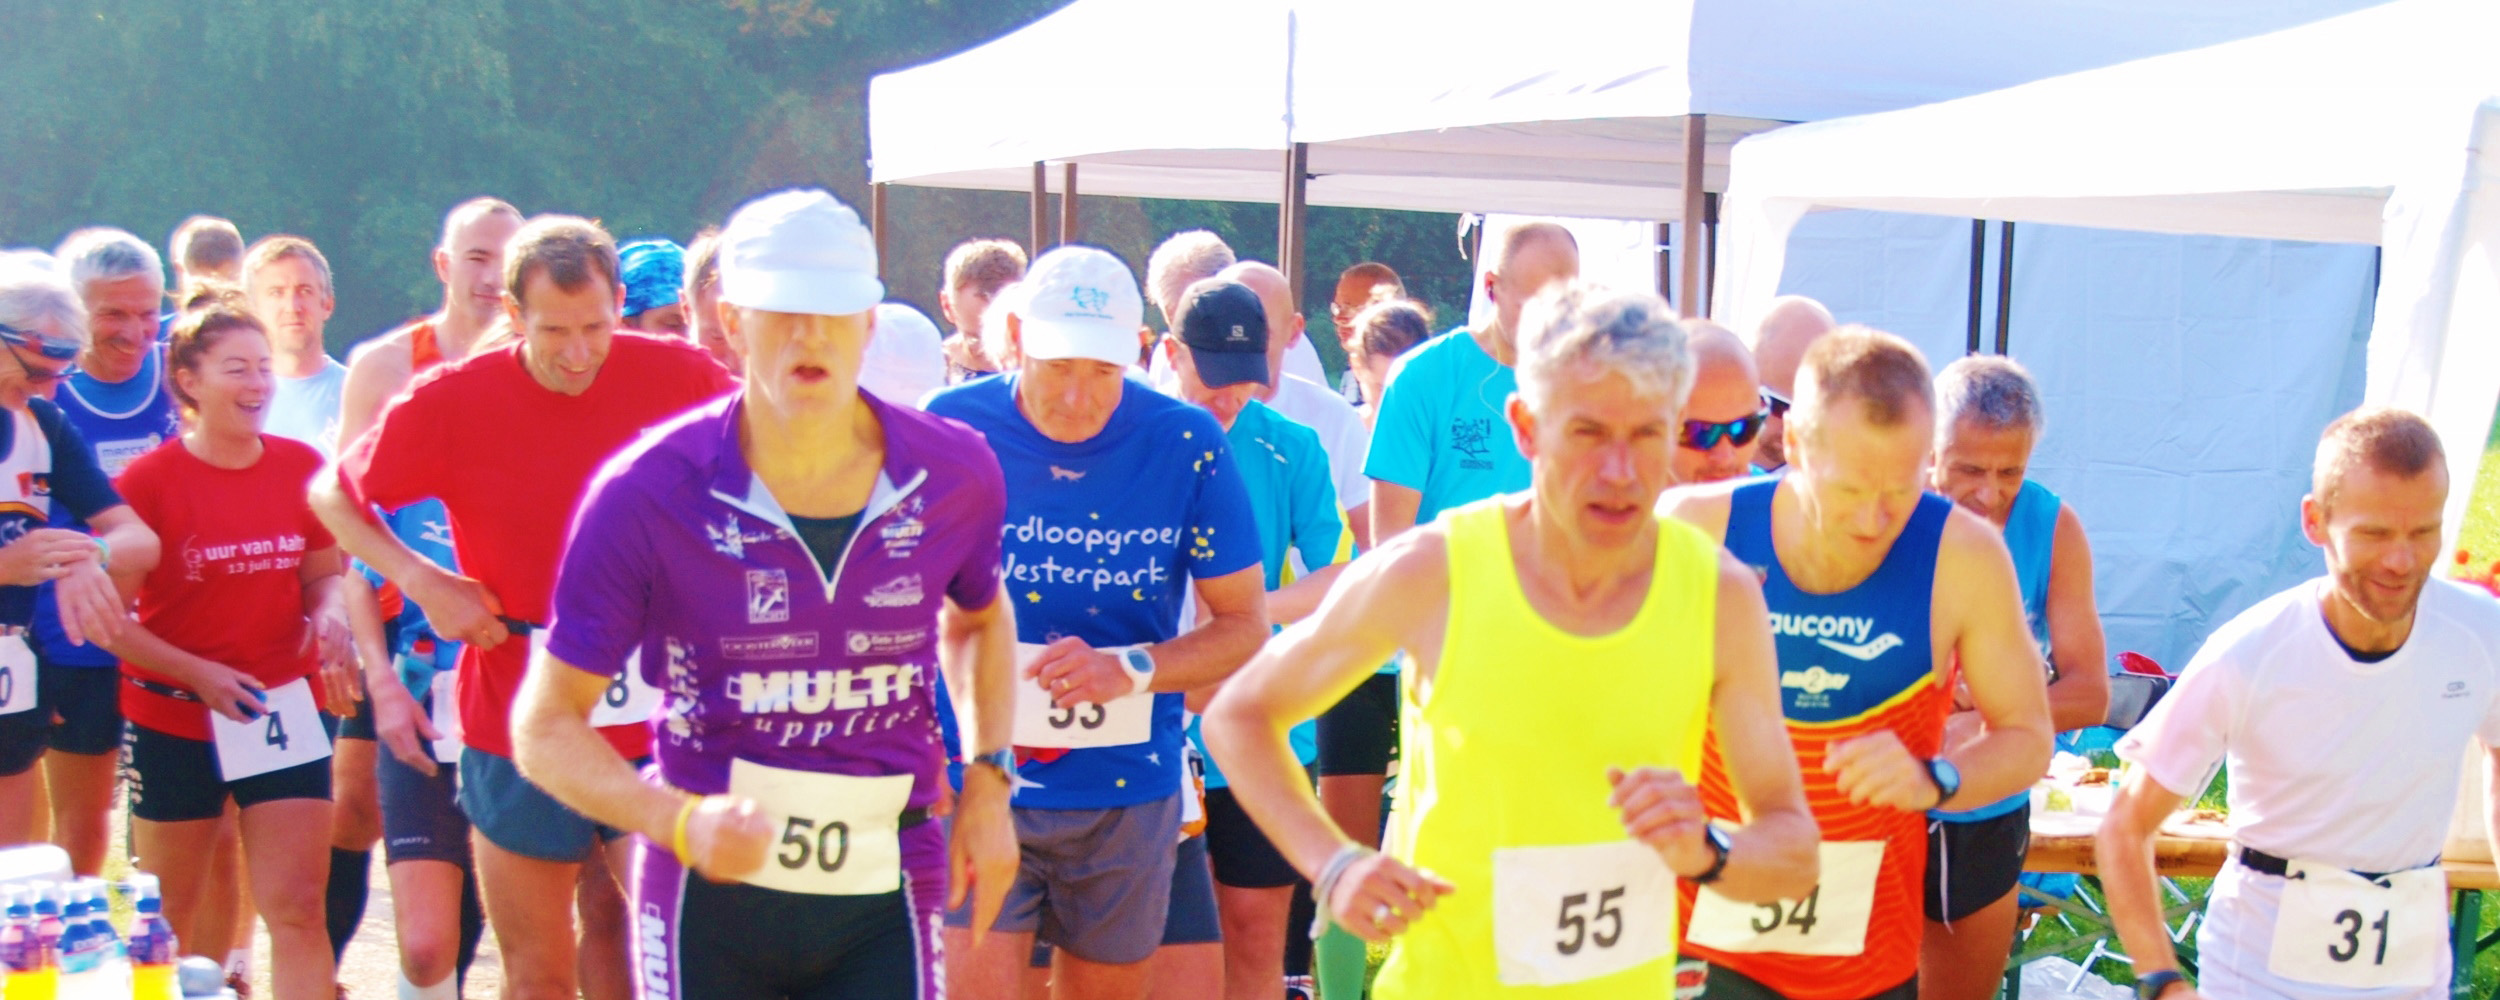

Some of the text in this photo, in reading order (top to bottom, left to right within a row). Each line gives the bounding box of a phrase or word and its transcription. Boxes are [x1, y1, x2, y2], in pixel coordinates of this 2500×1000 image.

[205, 545, 237, 561] uur
[241, 540, 274, 556] van
[227, 563, 246, 575] 13
[248, 558, 272, 574] juli
[266, 710, 289, 751] 4
[778, 816, 849, 873] 50
[1557, 885, 1626, 955] 55
[2328, 909, 2389, 965] 31
